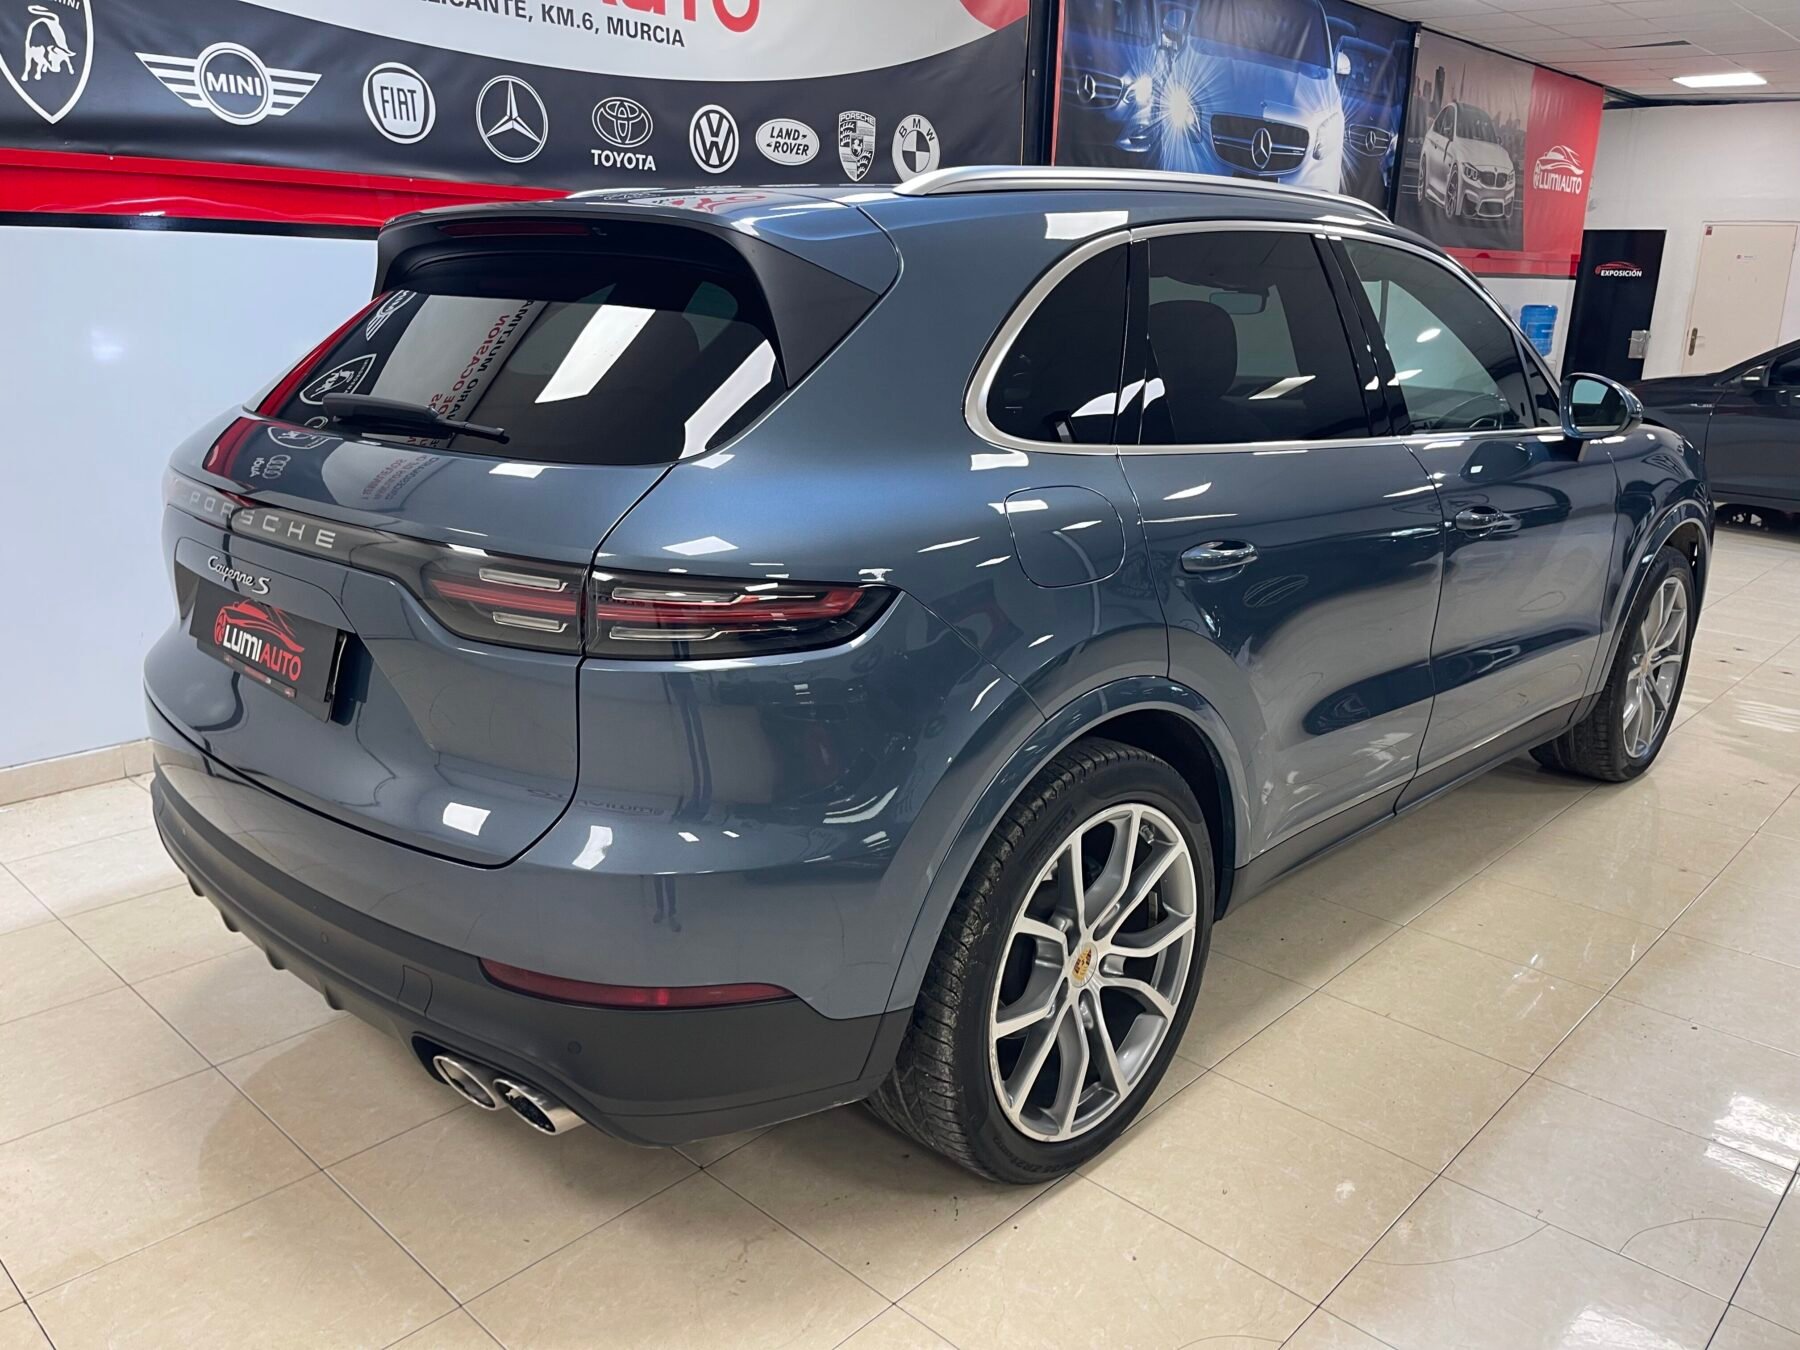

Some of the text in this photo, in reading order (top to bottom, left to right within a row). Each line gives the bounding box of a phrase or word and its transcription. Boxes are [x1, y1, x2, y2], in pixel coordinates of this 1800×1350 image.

[542, 4, 599, 34] KM.6,
[607, 16, 685, 47] MURCIA
[206, 71, 262, 96] MINI
[380, 86, 417, 122] FIAT
[840, 112, 876, 127] PORSCHE
[591, 149, 657, 171] TOYOTA
[1601, 269, 1642, 277] EXPOSICIÓN
[190, 493, 336, 549] PORSCHE
[207, 555, 271, 595] Cayenne S
